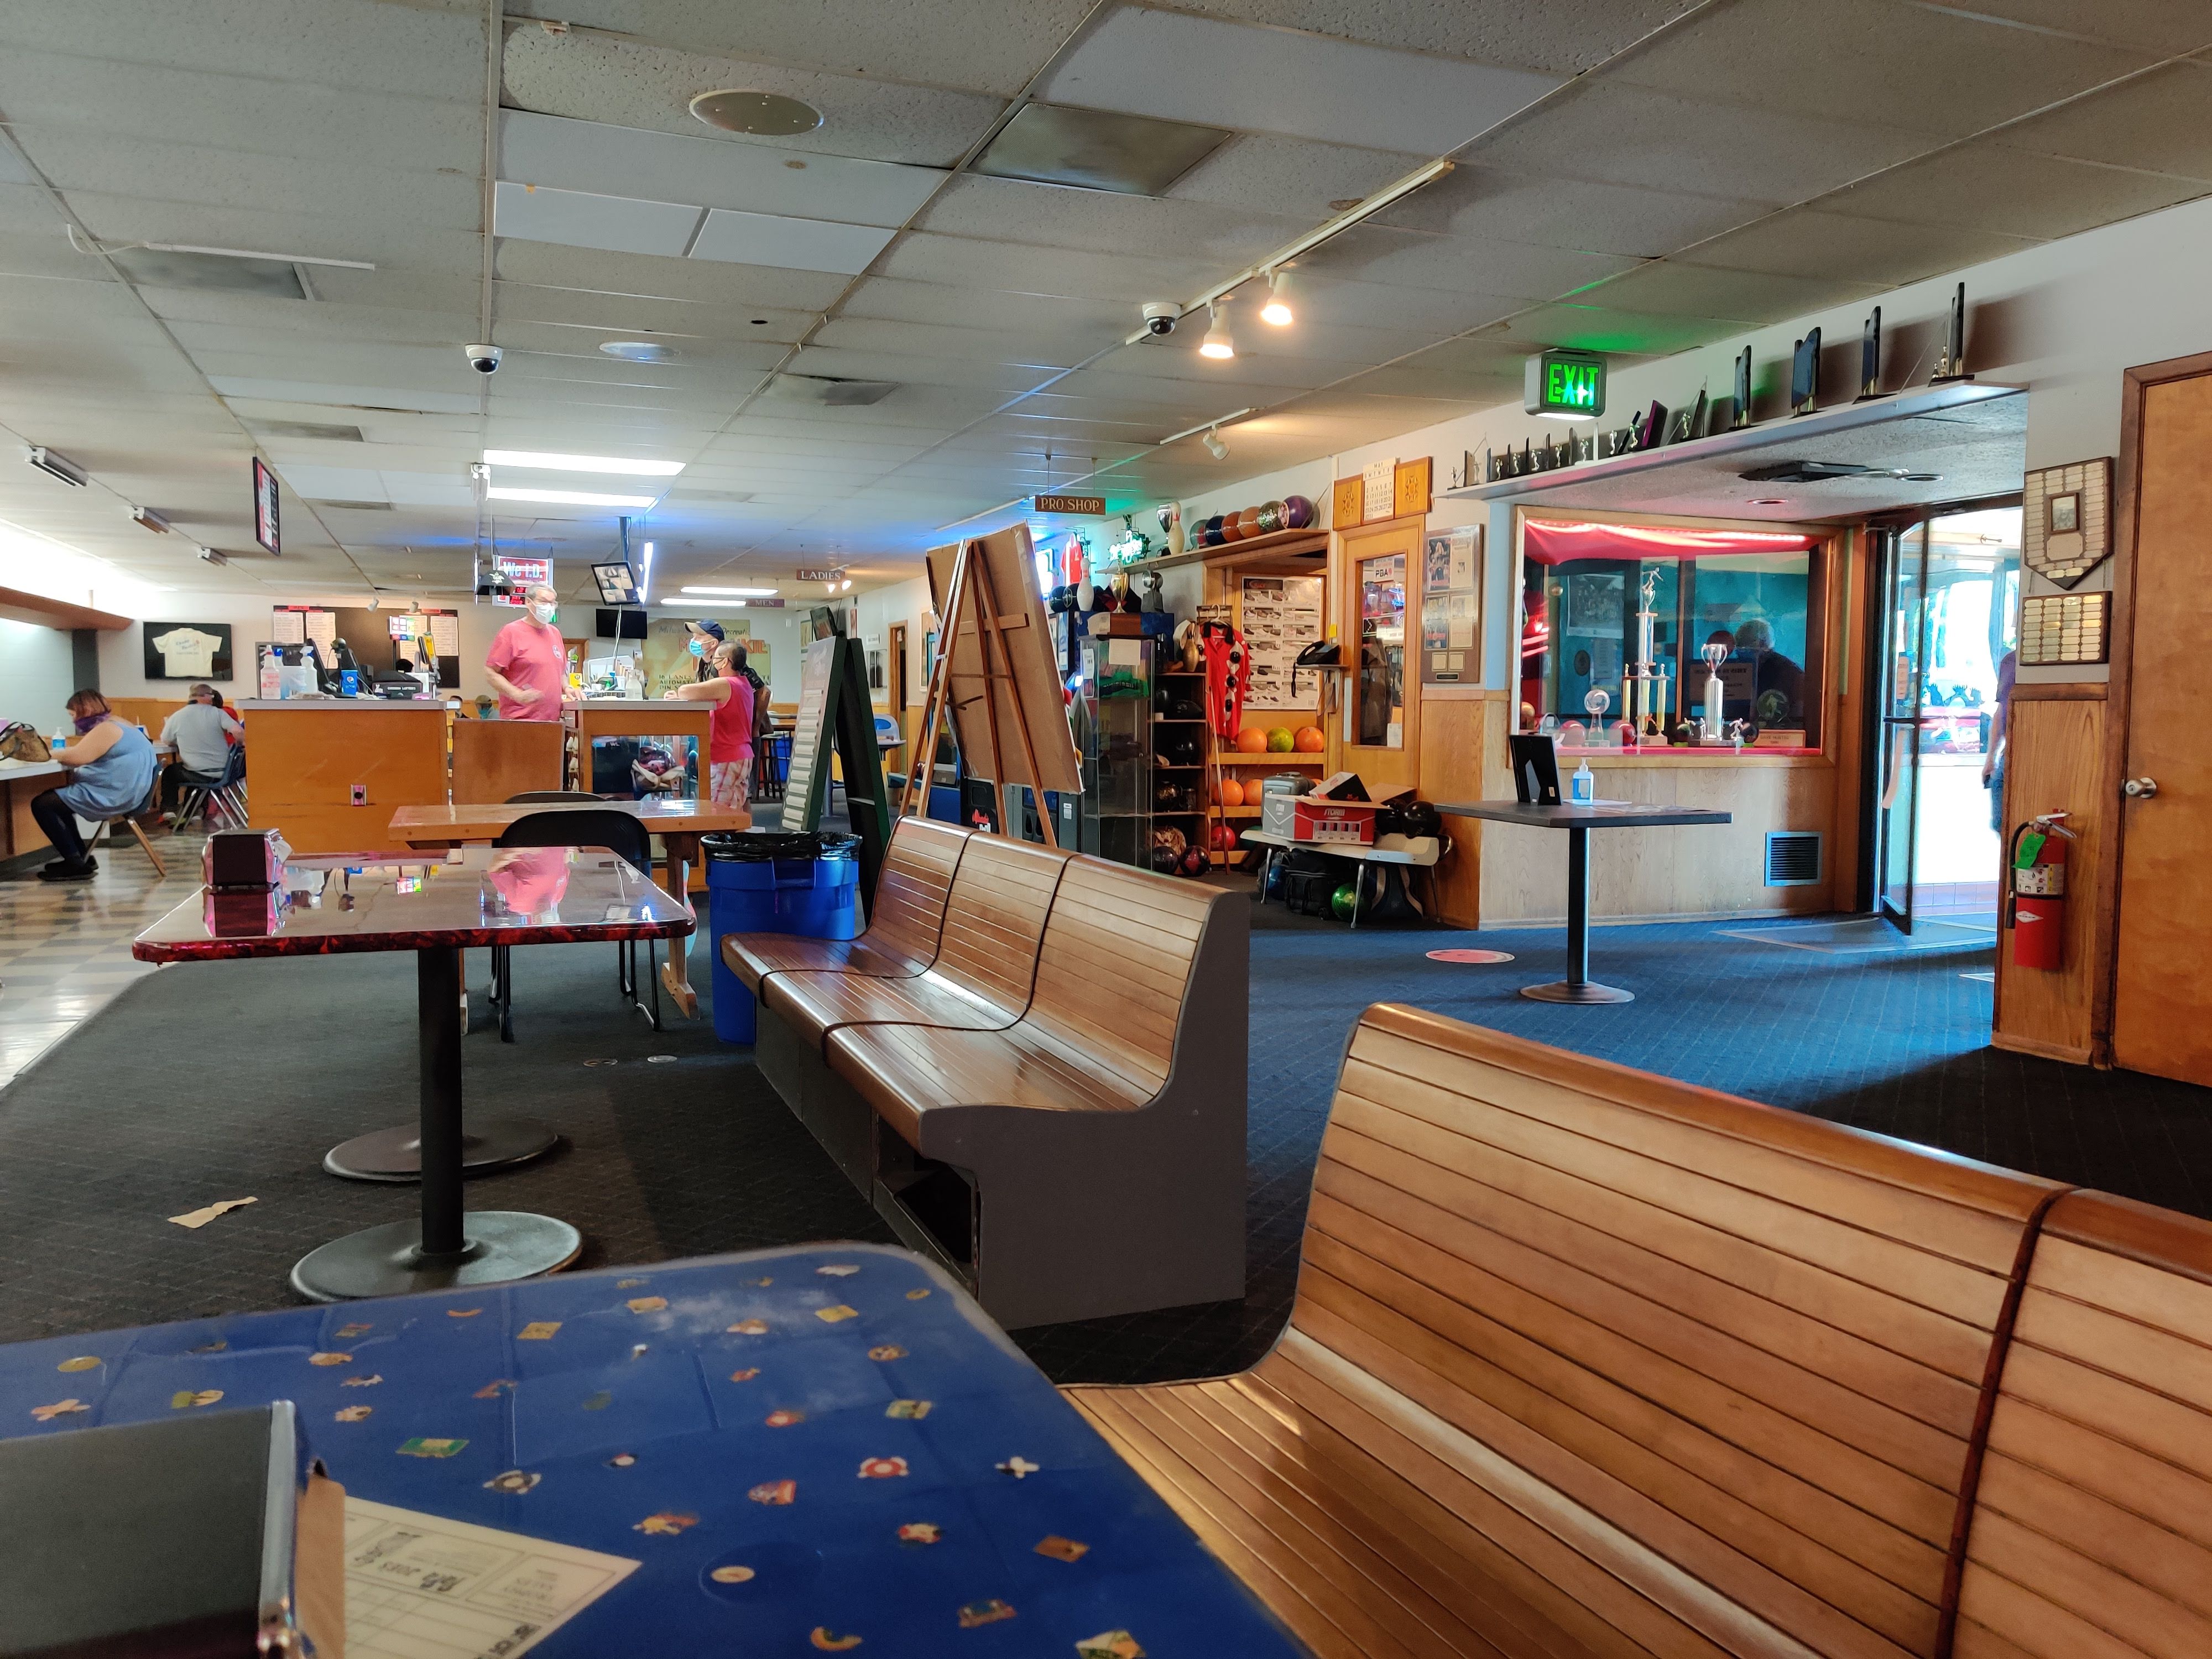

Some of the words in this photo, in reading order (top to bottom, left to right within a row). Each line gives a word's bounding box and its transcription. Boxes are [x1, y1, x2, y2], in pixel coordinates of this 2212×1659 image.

[1548, 363, 1599, 405] EXIT
[1040, 497, 1065, 510] PRO
[1067, 498, 1100, 512] SHOP
[503, 561, 521, 577] We
[801, 570, 841, 580] LADIES
[1324, 808, 1345, 816] STORM
